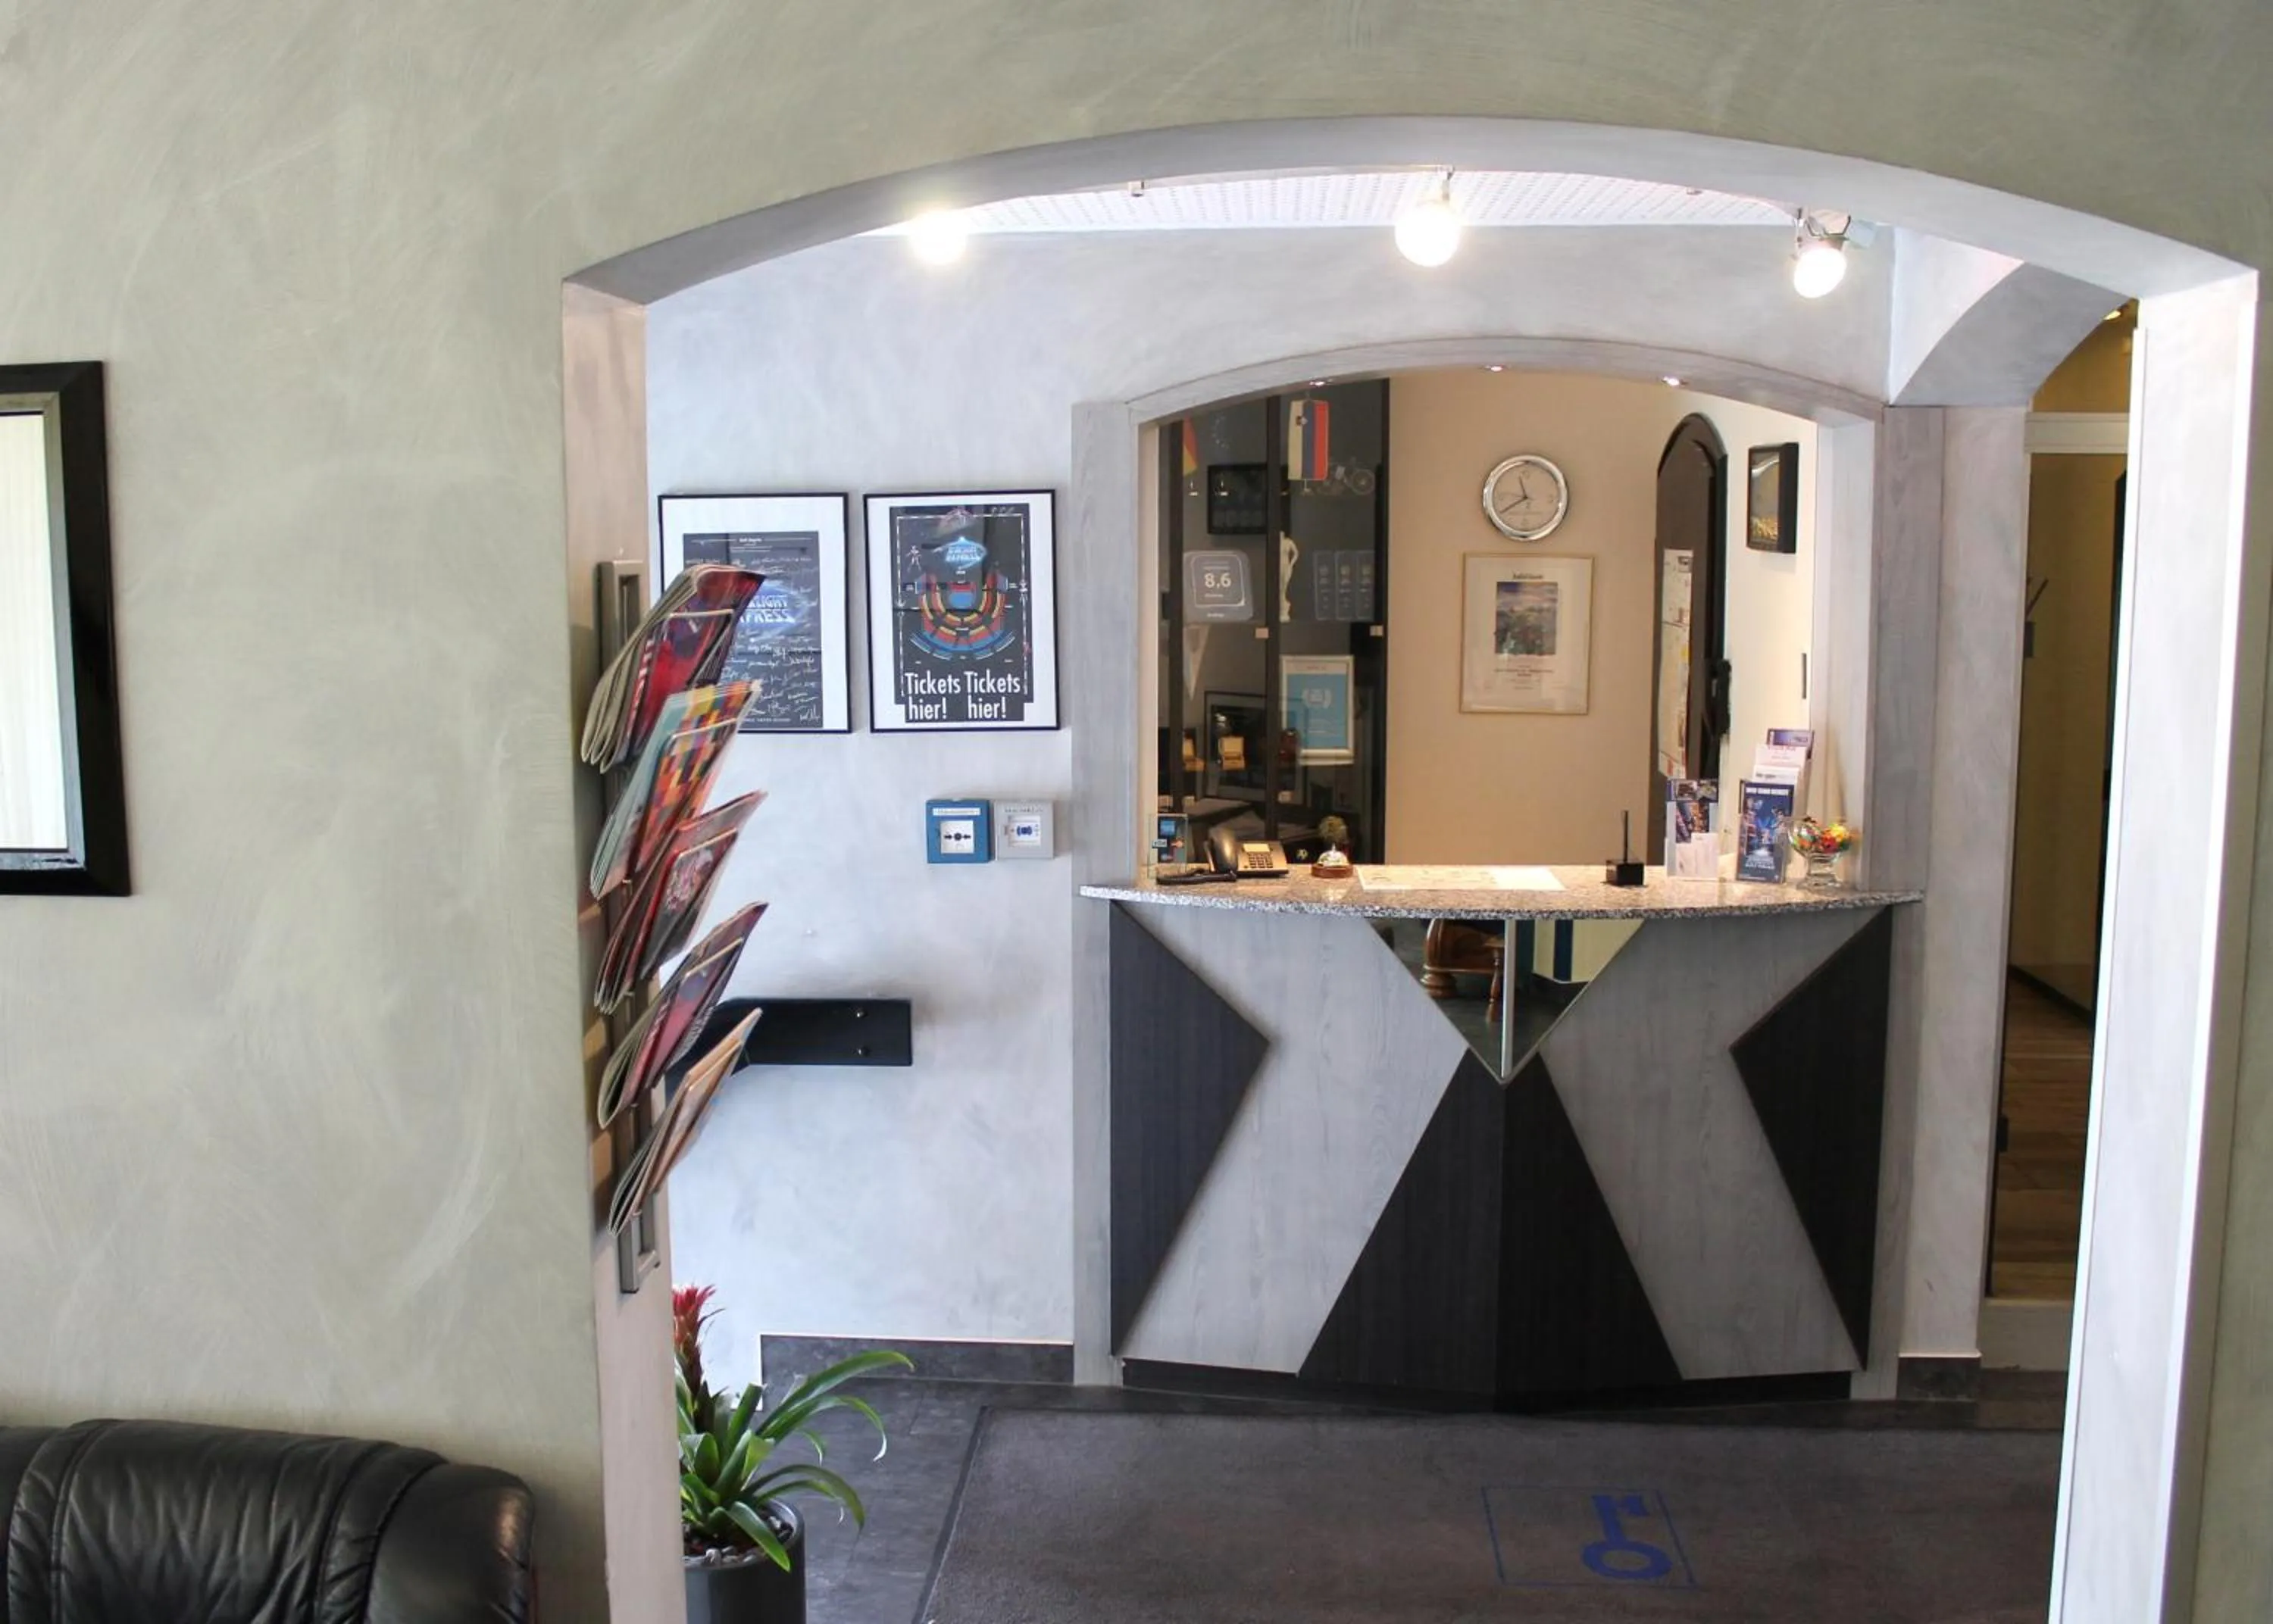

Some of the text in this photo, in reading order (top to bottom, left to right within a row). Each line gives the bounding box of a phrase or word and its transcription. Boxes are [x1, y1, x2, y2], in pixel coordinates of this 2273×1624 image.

[1205, 573, 1231, 589] 8,6
[905, 668, 1021, 695] Tickets Tickets
[909, 695, 1006, 720] hier! hier!
